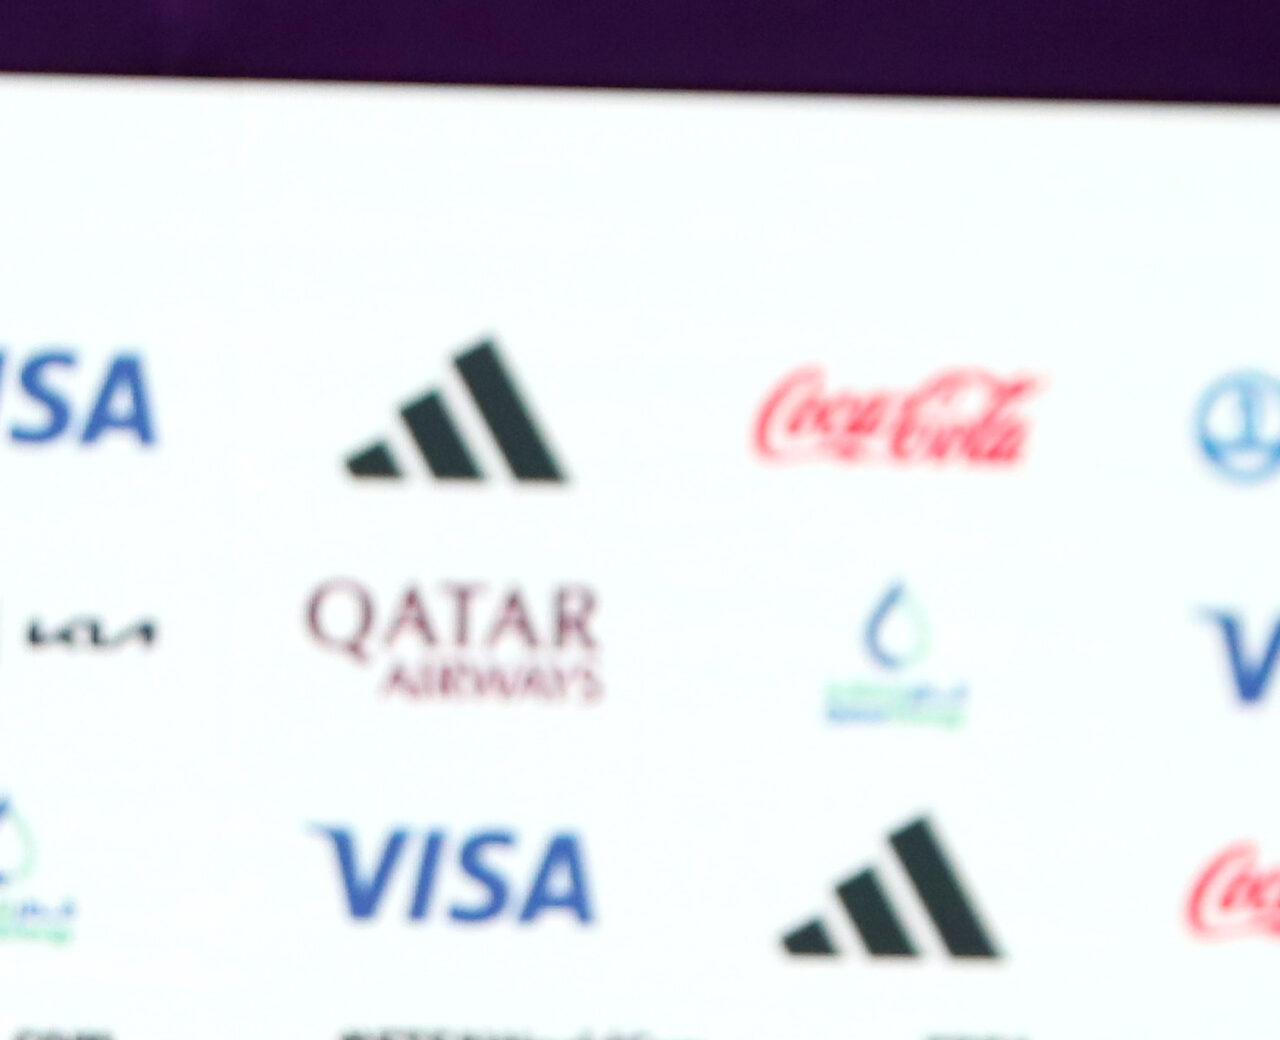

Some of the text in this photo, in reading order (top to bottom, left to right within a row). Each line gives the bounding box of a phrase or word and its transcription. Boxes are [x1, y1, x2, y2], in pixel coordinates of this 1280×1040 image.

[304, 577, 602, 664] QATAR
[380, 663, 604, 706] AIRWAYS
[308, 822, 596, 927] VISA
